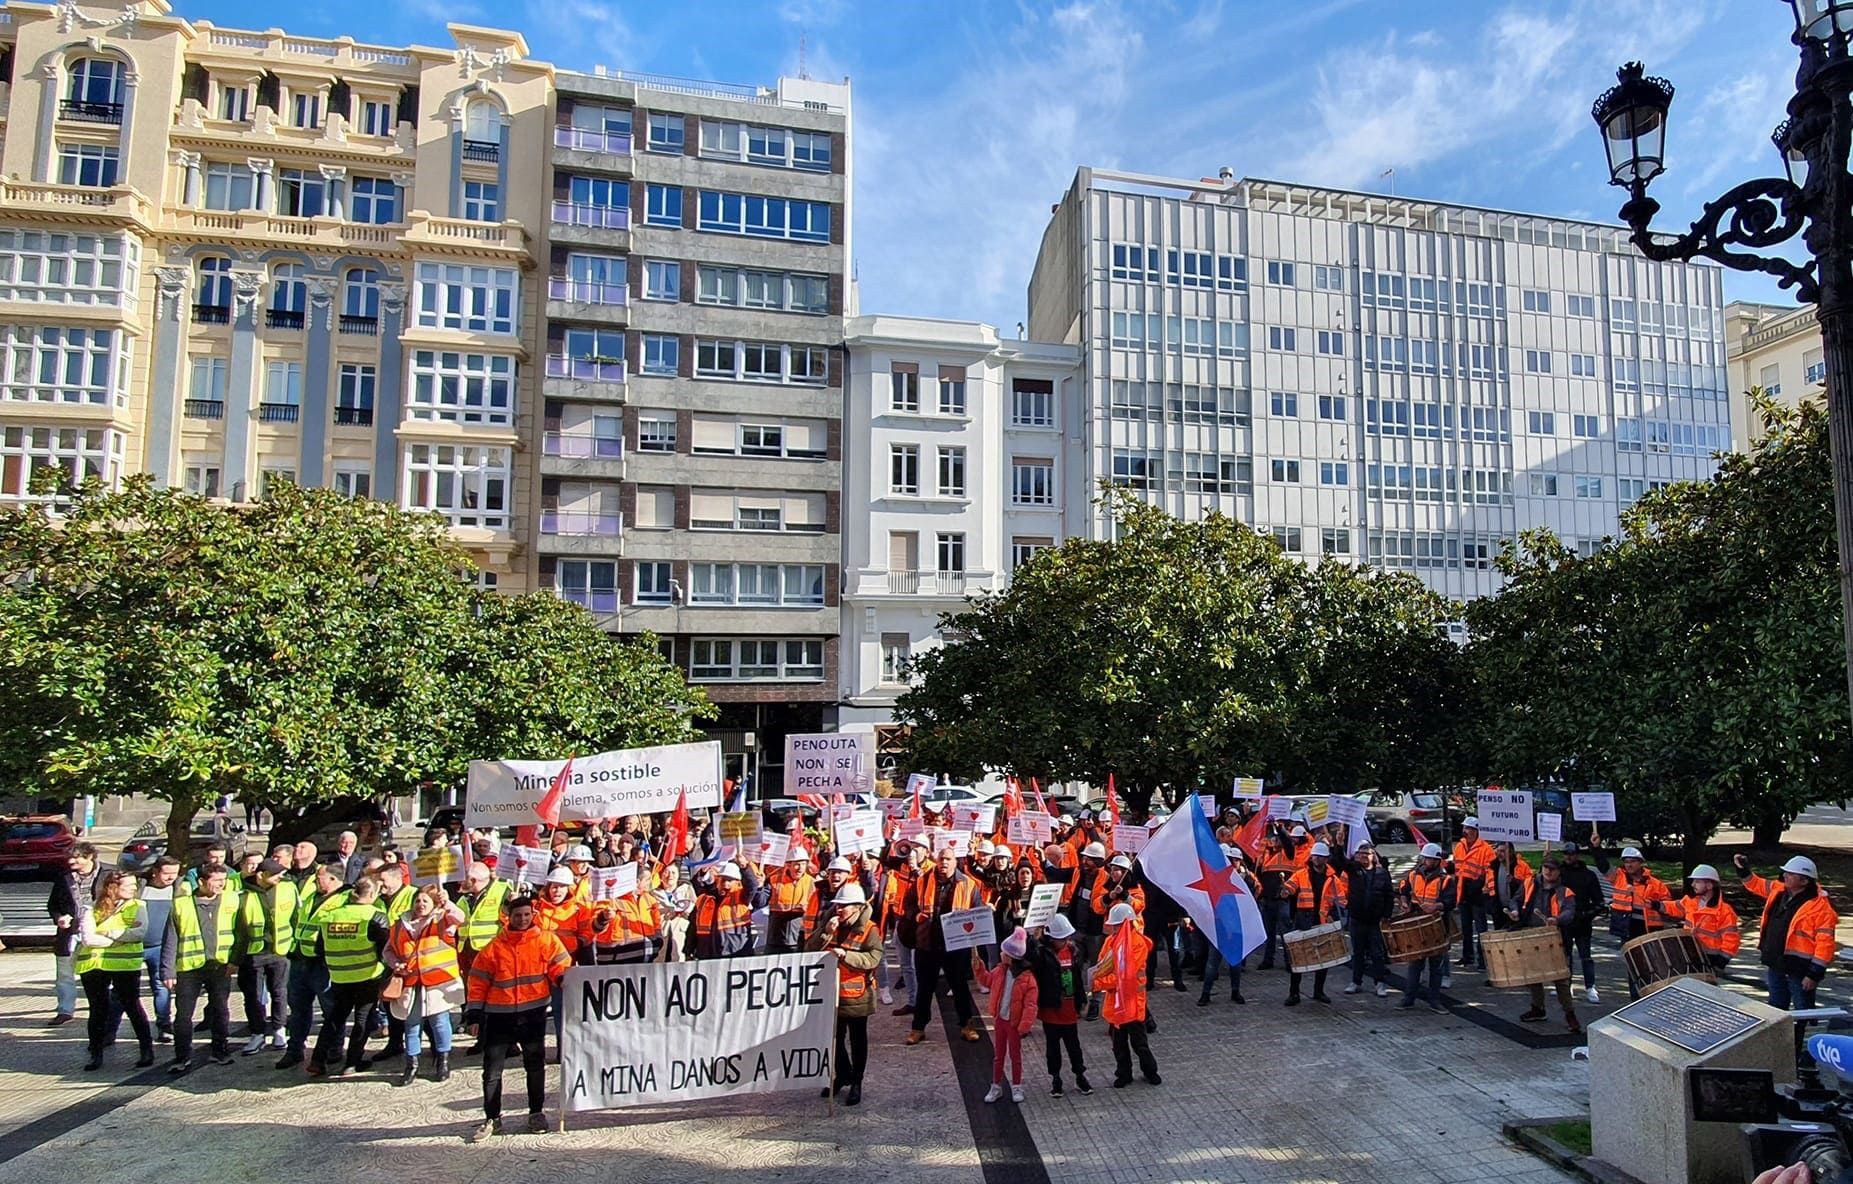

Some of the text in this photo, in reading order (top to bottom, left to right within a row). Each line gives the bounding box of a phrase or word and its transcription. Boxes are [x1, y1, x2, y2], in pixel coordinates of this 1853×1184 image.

[795, 758, 851, 770] NON SE
[514, 764, 661, 791] Mineía sostible
[471, 802, 492, 813] Non
[494, 802, 528, 813] somos
[611, 789, 652, 803] somos
[656, 788, 663, 797] a
[1478, 795, 1525, 804] PENSO NO
[1491, 811, 1519, 819] FUTURO
[1508, 829, 1530, 837] PURO
[582, 964, 825, 1022] NON AO PECHE
[571, 1048, 830, 1098] A MINA DANOS A VIDA
